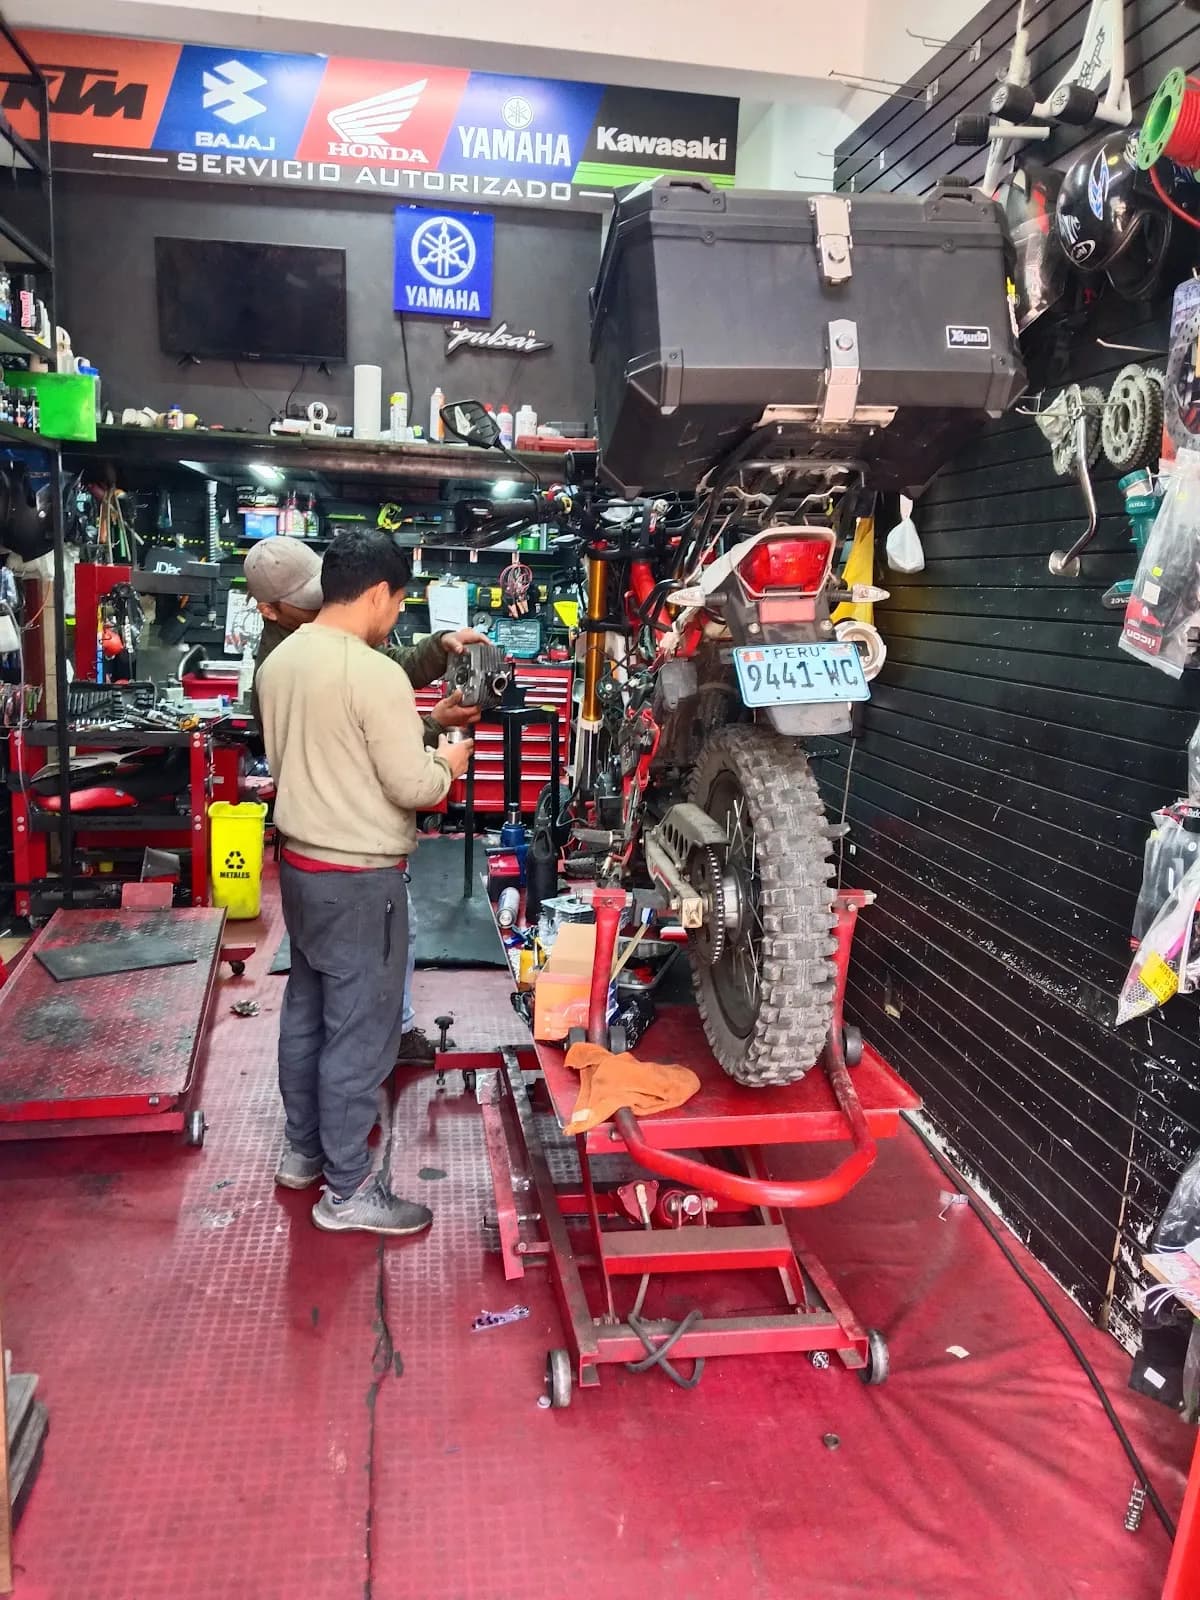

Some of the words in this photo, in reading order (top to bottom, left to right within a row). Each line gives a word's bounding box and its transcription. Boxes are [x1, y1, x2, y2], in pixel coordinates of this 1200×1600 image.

[0, 63, 148, 120] KTM
[195, 131, 275, 151] BAJAJ
[327, 141, 430, 164] HONDA
[458, 125, 572, 167] YAMAHA
[596, 126, 727, 161] Kawasaki
[177, 152, 341, 182] SERVICIO
[355, 166, 572, 201] AUTORIZADO
[405, 285, 480, 312] YAMAHA
[773, 647, 821, 659] PERU
[747, 659, 859, 692] 9441-WC
